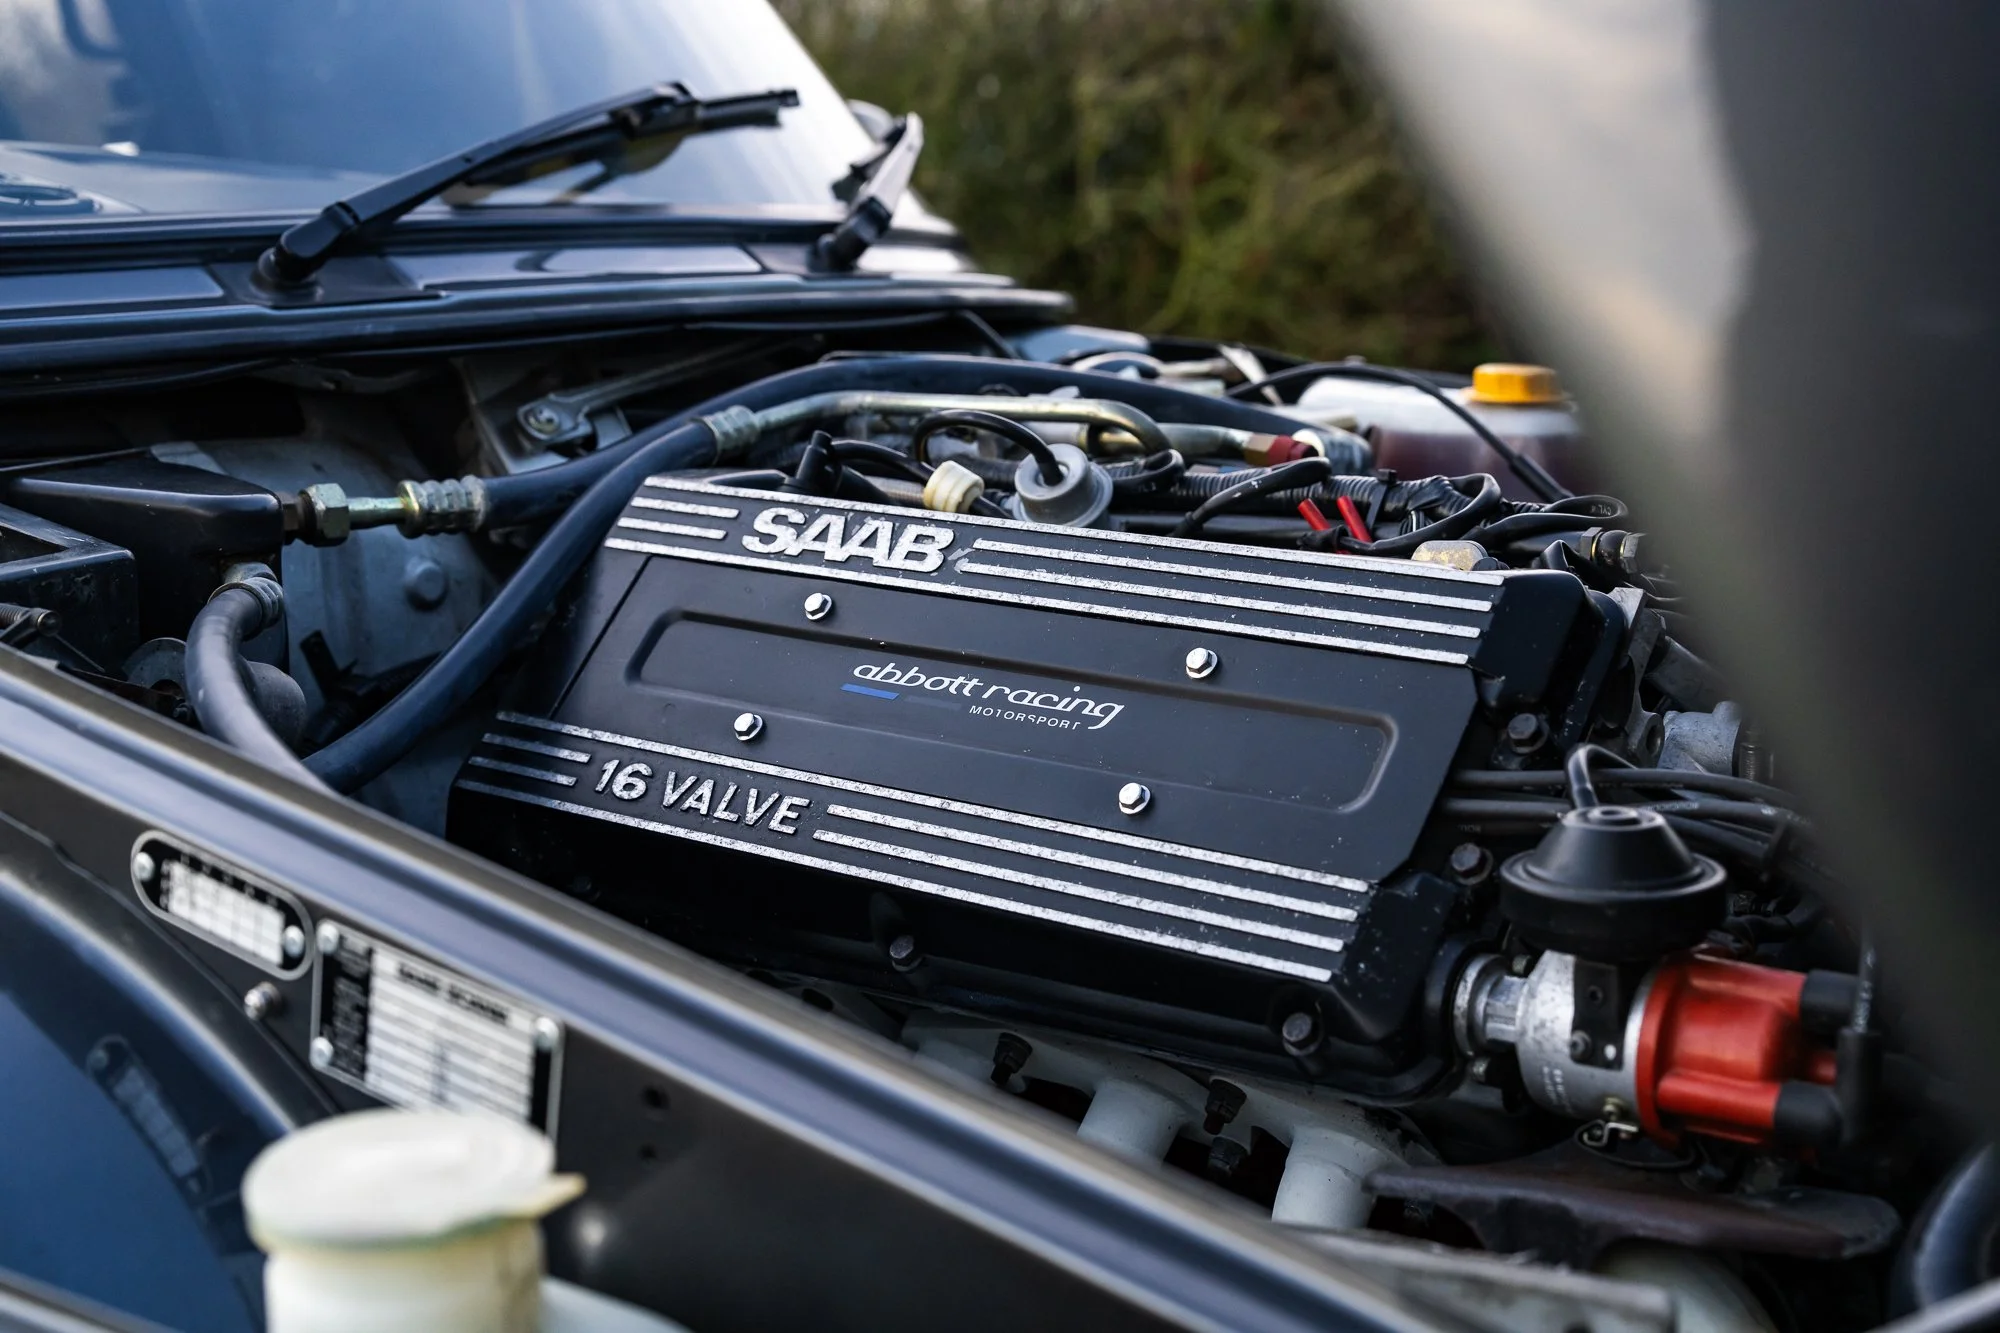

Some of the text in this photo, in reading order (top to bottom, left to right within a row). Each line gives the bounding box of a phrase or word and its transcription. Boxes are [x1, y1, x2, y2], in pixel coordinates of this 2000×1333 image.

[741, 507, 954, 573] SAAB
[853, 662, 1125, 730] abbott racing
[969, 705, 1081, 730] MOTORSPORT
[595, 759, 810, 835] 16 VALVE
